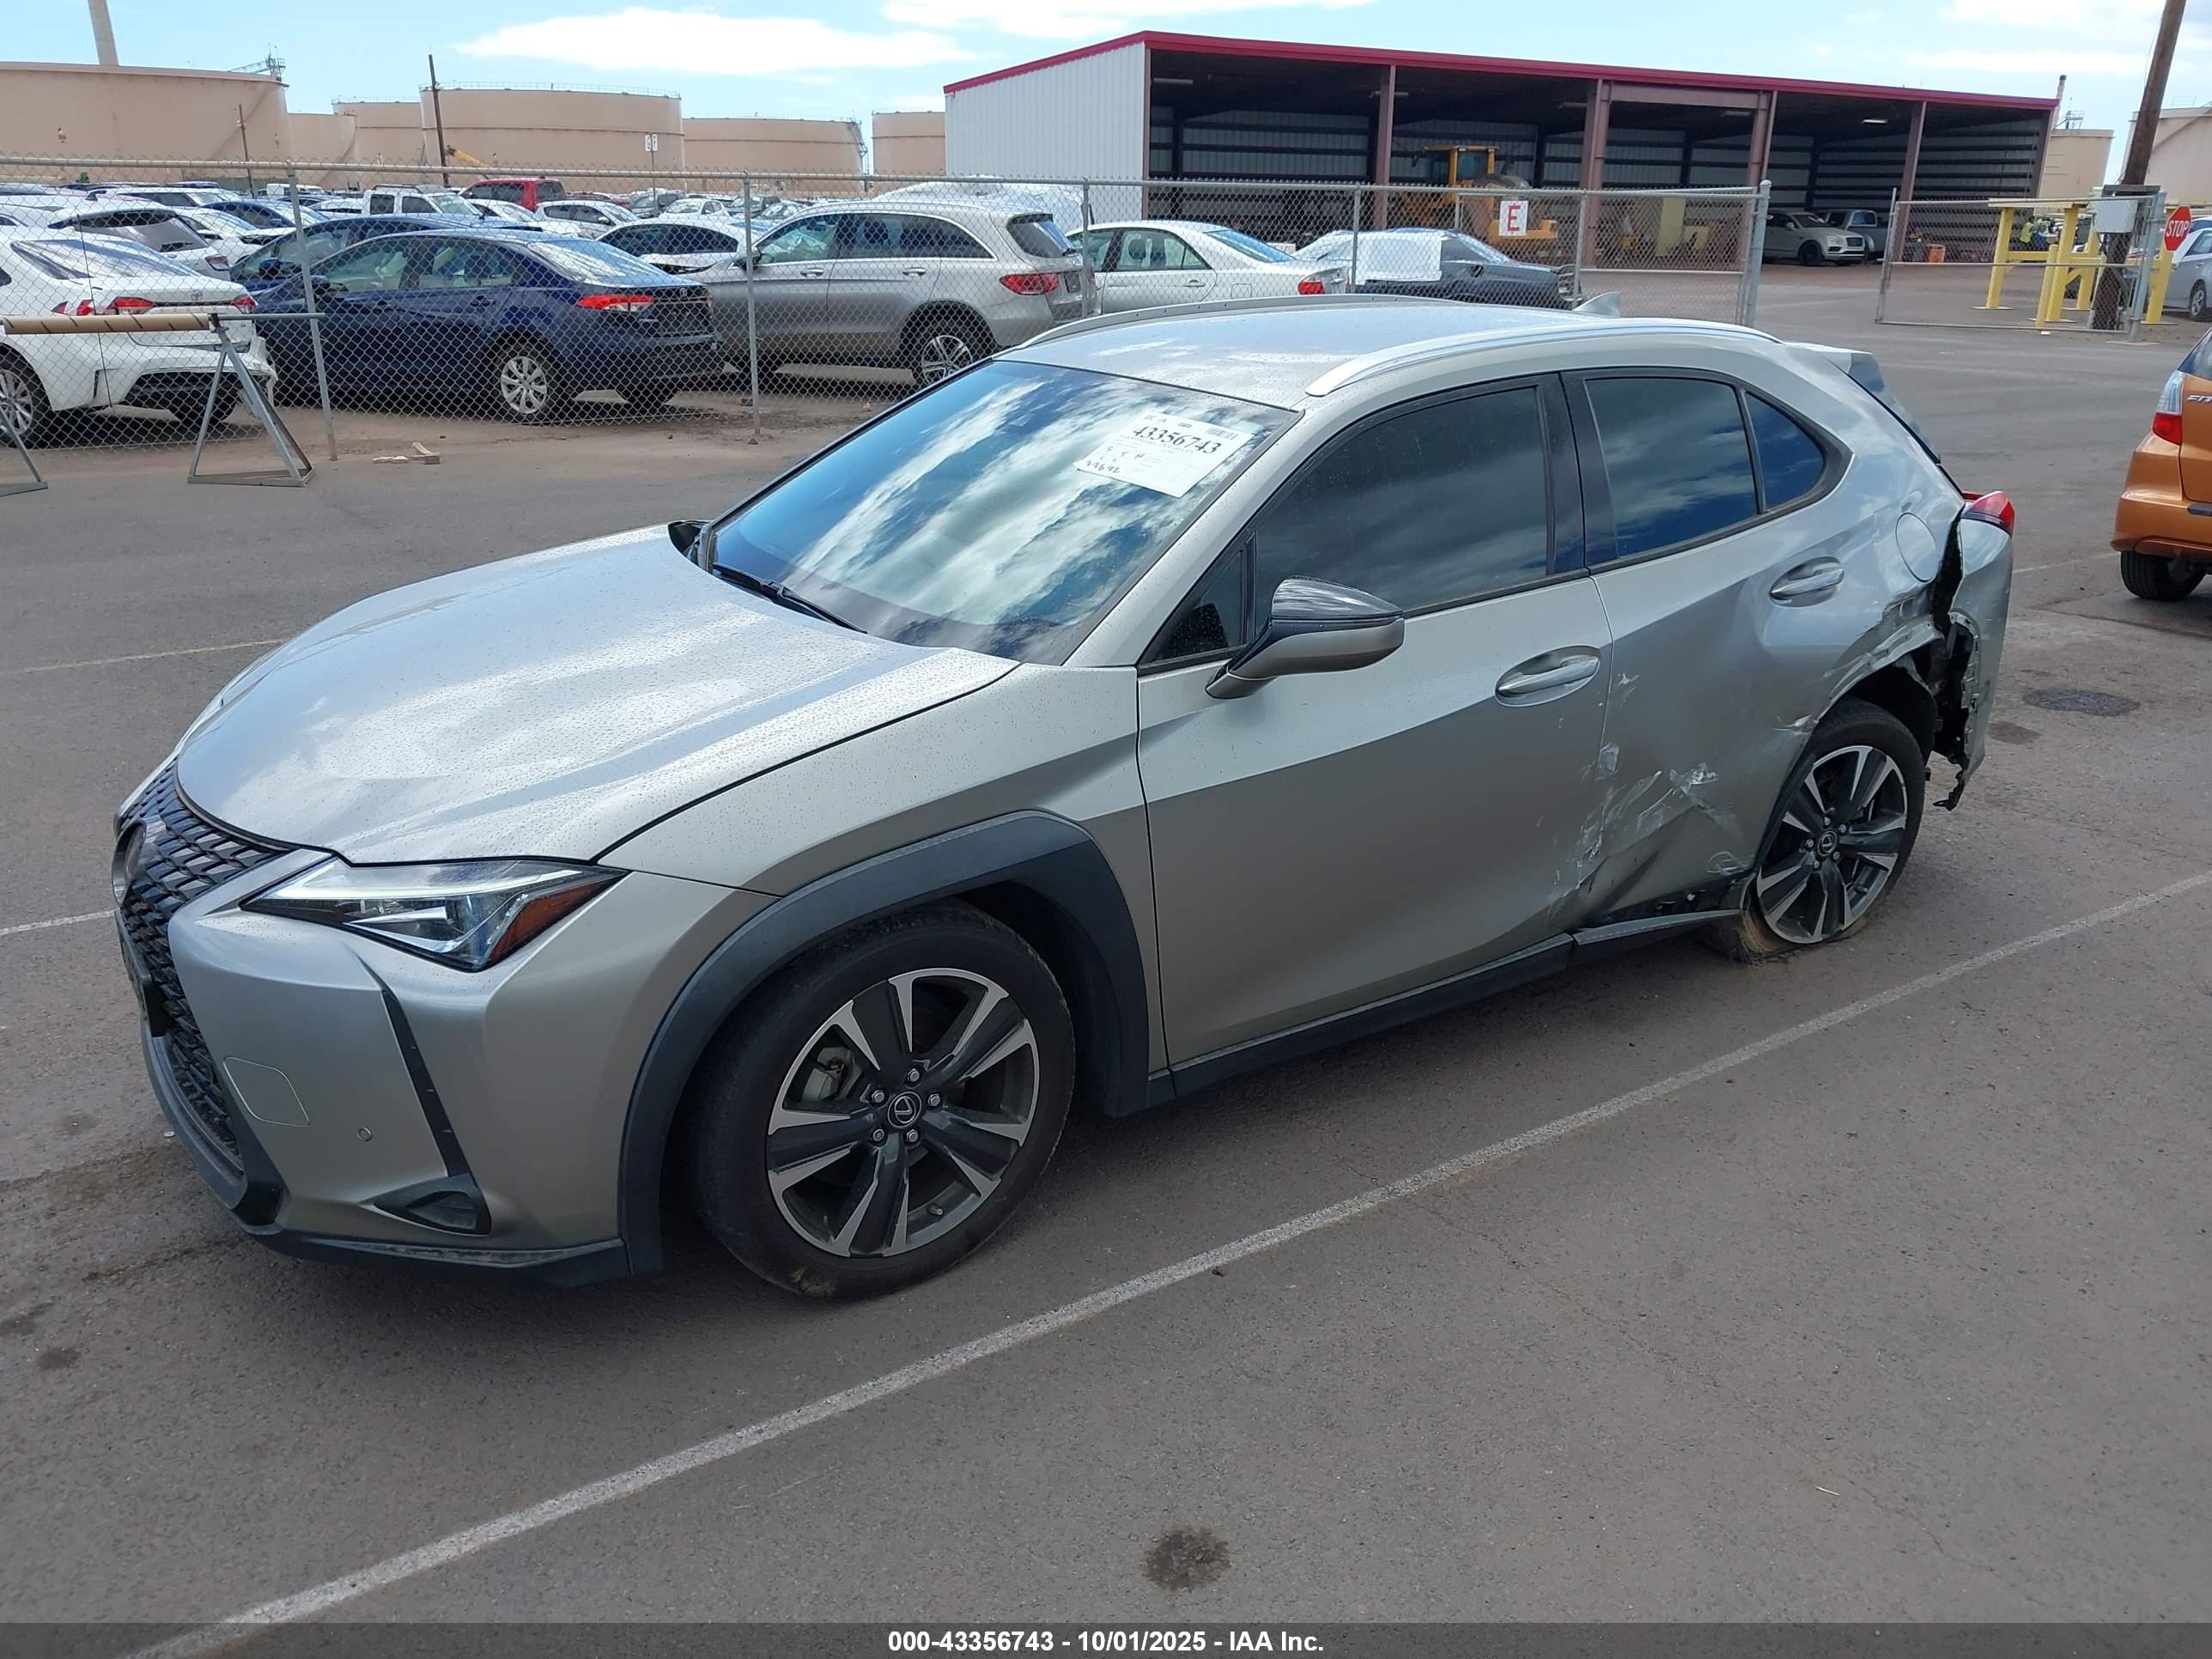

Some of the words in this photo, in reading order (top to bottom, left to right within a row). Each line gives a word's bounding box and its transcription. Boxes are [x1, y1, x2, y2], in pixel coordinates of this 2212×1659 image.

[1507, 205, 1521, 232] E
[2166, 220, 2190, 237] STOP
[1132, 425, 1222, 454] 43356743
